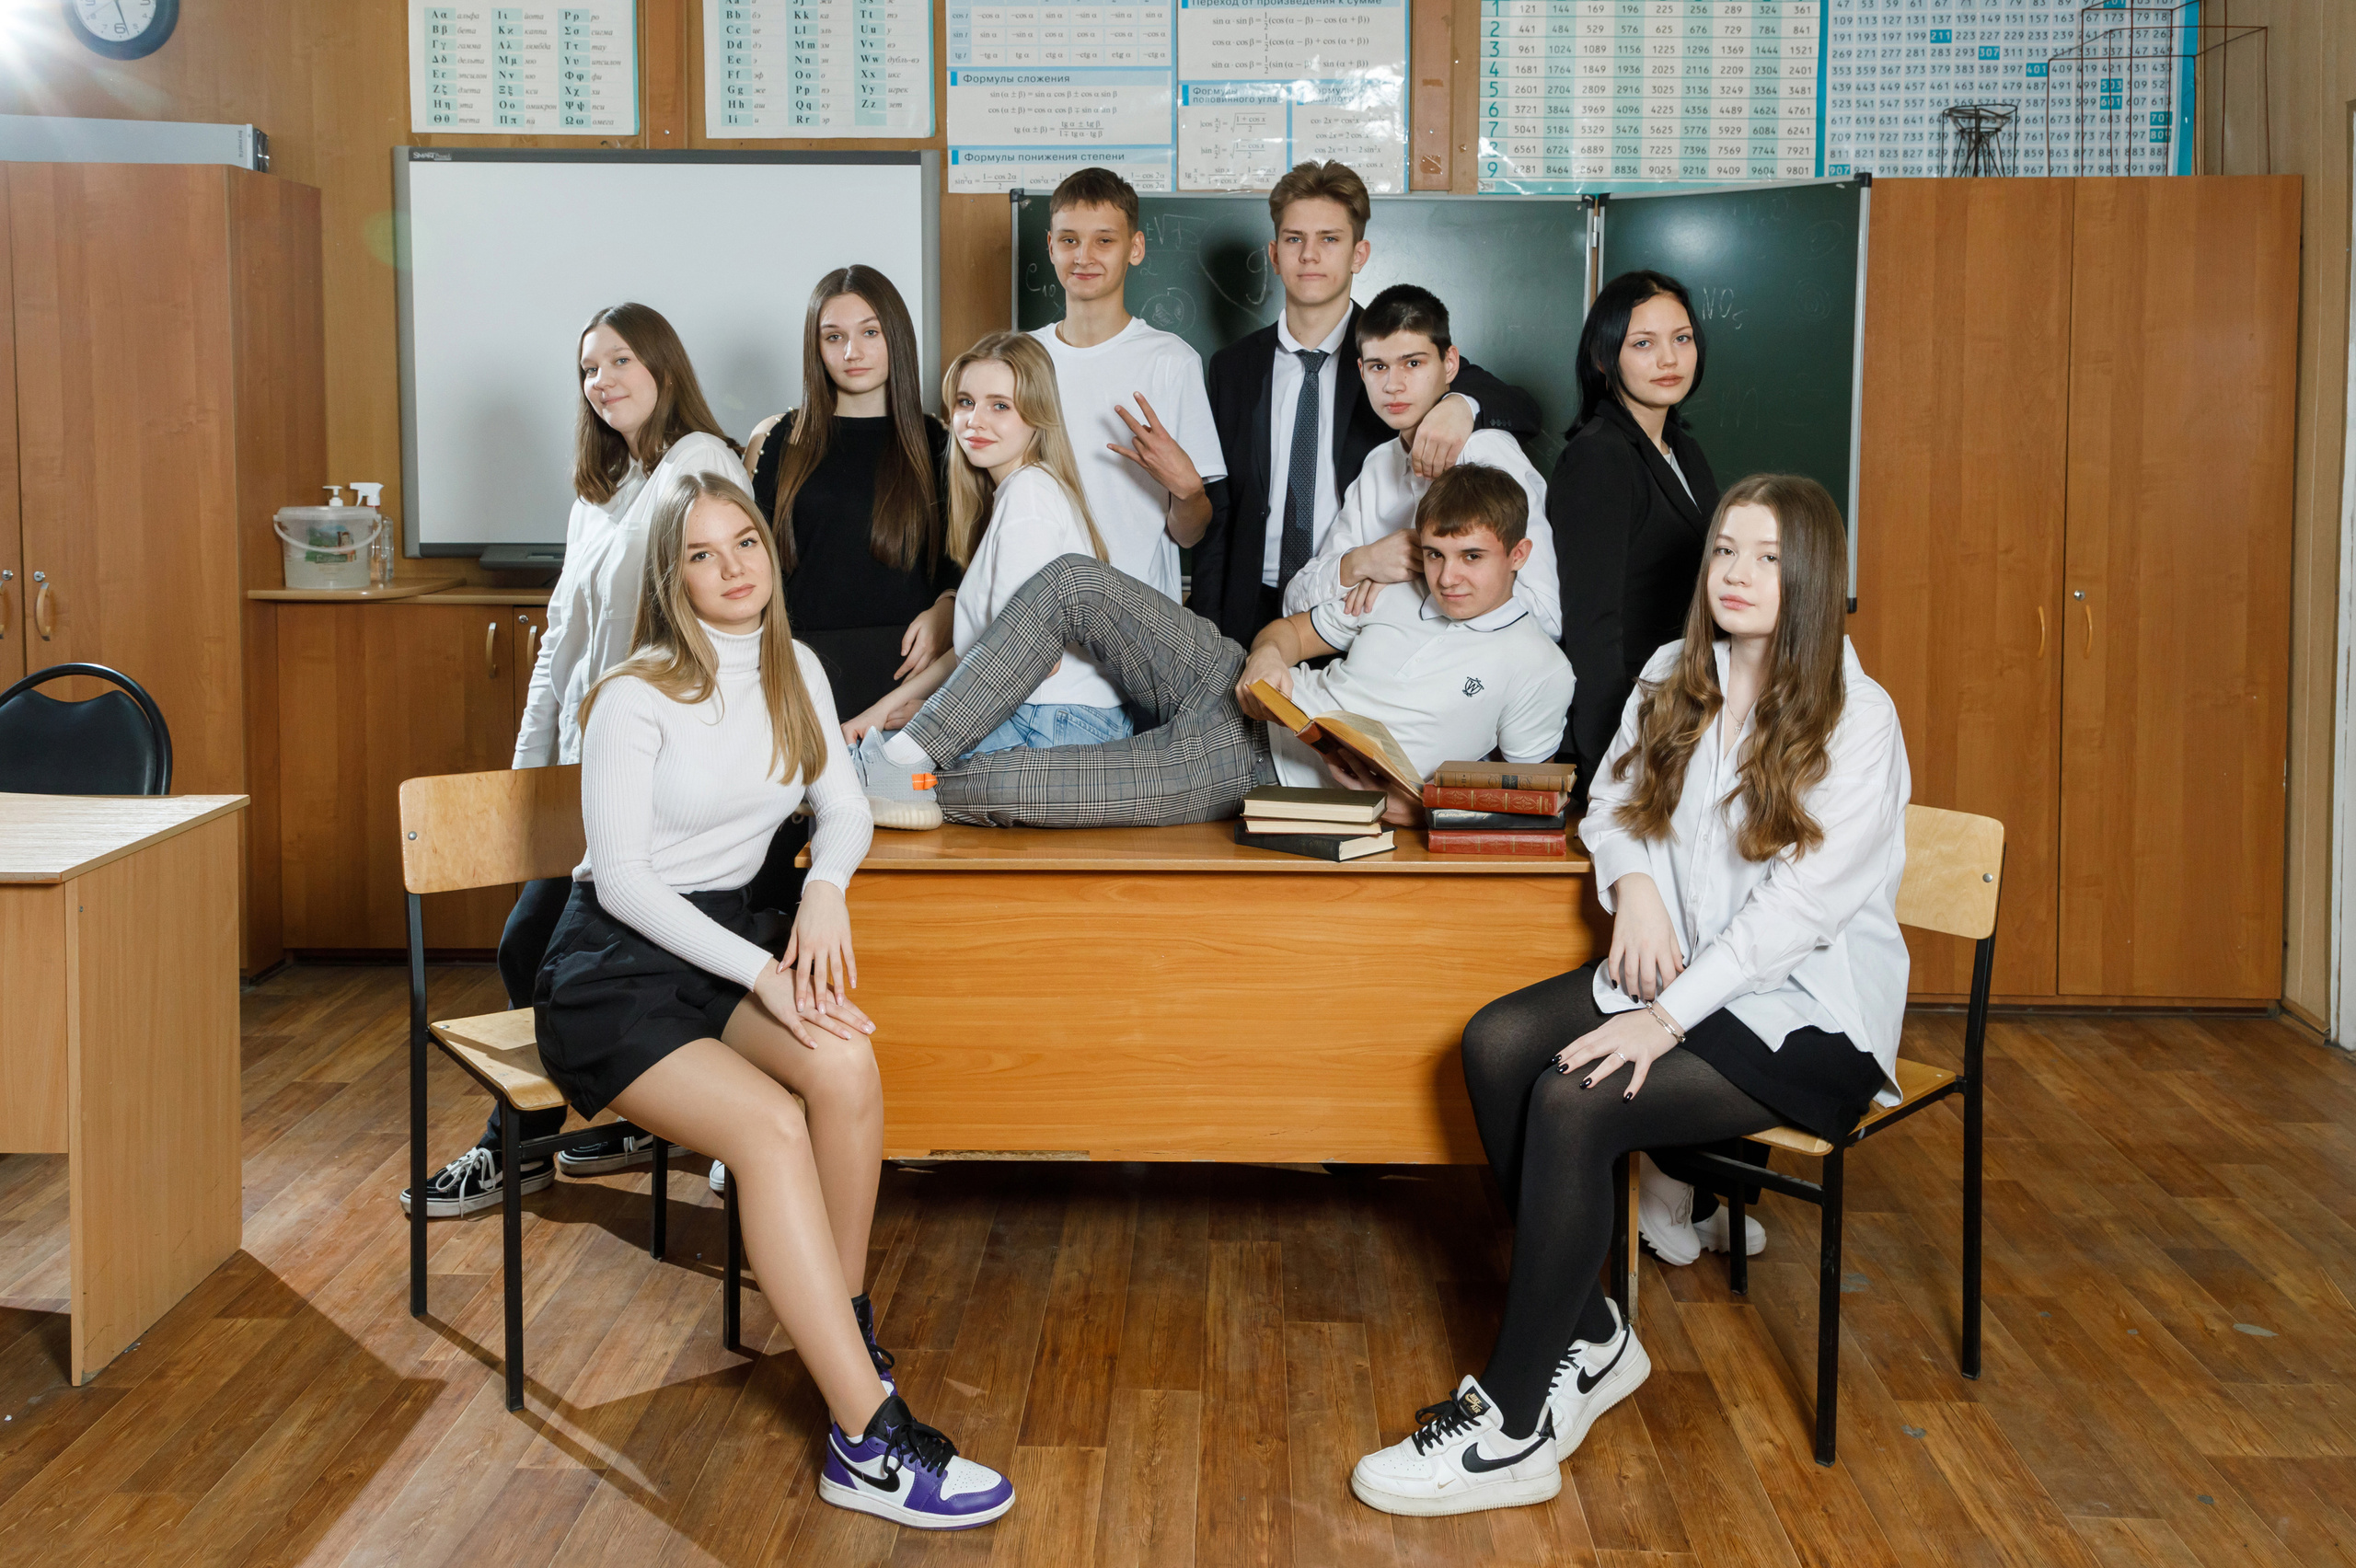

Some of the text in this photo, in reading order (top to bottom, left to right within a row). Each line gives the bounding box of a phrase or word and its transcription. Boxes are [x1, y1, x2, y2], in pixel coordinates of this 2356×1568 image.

[1833, 13, 2074, 26] 109 113 127 131 137 139 149 151 157 163
[1489, 41, 1812, 57] 3 961 1024 1089 1156 1225 1296 1369 1444 1521
[1489, 62, 1812, 77] 4 1681 1764 1849 1936 2025 2116 2209 2304 2401
[1832, 64, 2073, 75] 353 359 367 373 379 383 389 397 401 409
[963, 74, 1070, 85] Формулы сложения
[1489, 81, 1811, 98] 5 2601 2704 2809 2916 3025 3136 3249 3364 3481
[1831, 81, 2071, 92] 439 443 449 457 461 463 467 479 487 491
[1488, 101, 1811, 118] 6 3721 3844 3969 4096 4225 4356 4489 4624 4761
[964, 153, 1125, 163] Формулы понижения степени
